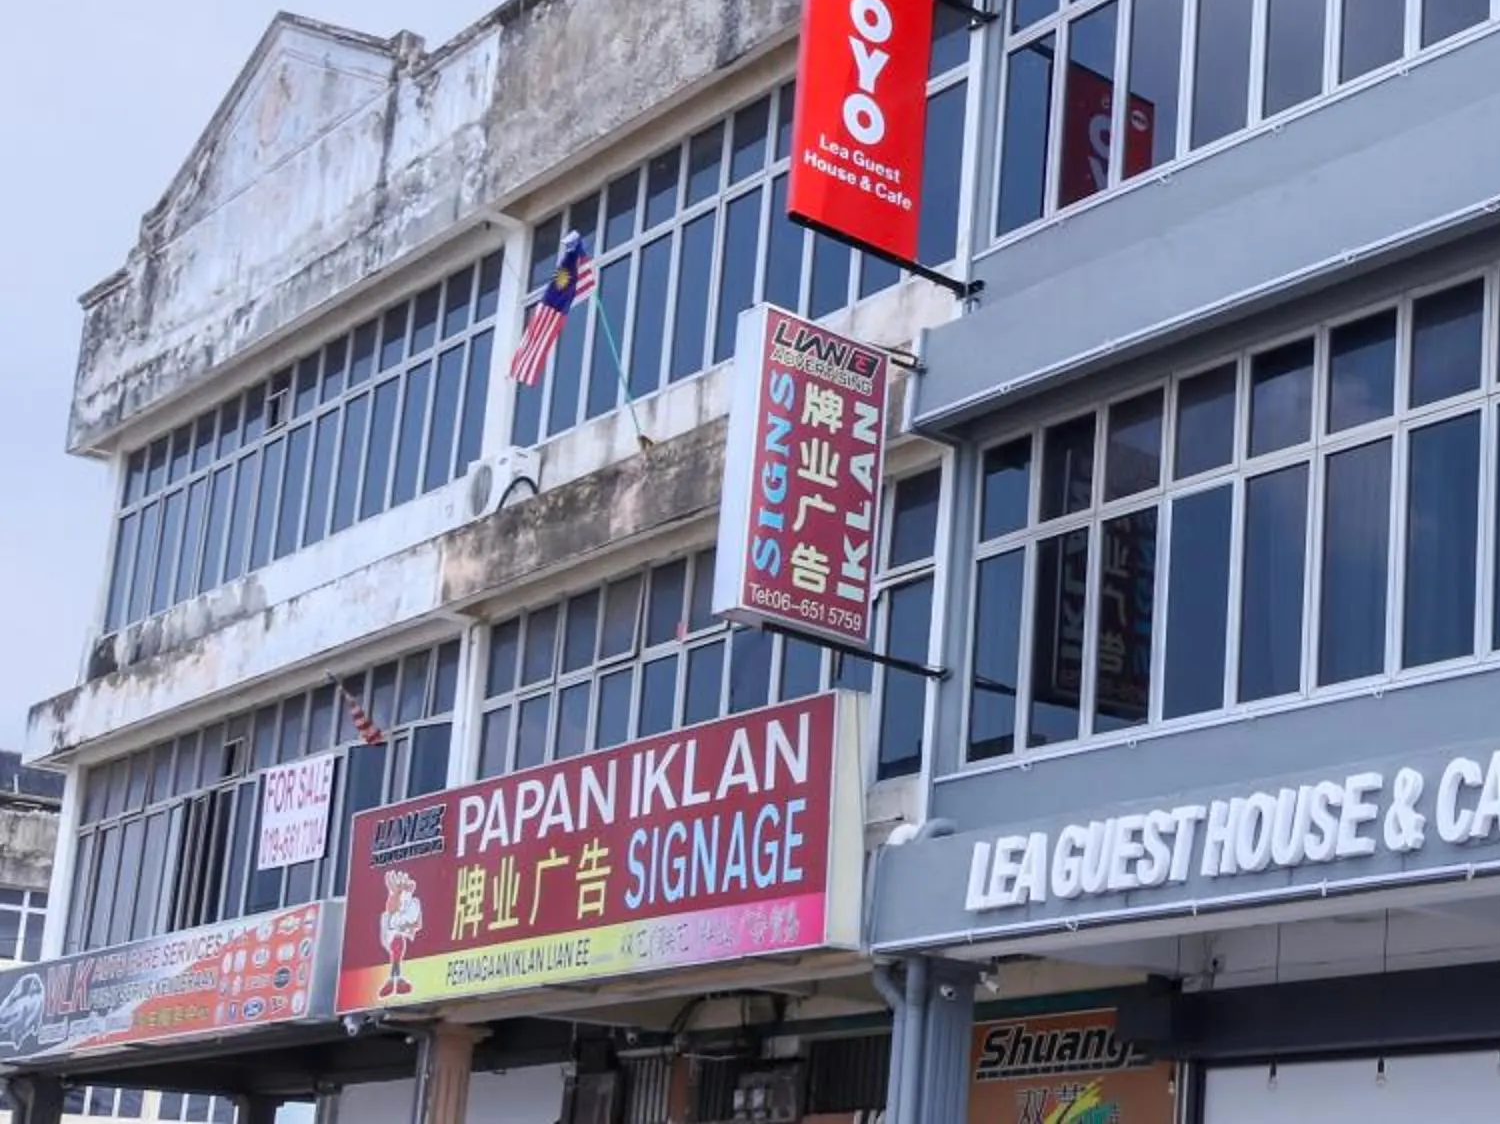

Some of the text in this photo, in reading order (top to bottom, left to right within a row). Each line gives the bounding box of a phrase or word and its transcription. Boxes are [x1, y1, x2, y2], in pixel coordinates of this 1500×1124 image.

[804, 149, 912, 211] House & Cafe
[819, 132, 901, 184] Lea Guest
[751, 369, 799, 578] SIGNS
[790, 380, 845, 594] 牌业广告
[836, 400, 879, 603] IKLAN
[827, 605, 862, 632] 5759
[265, 759, 332, 812] FOR SALE
[456, 713, 811, 859] PAPAN IKLAN
[964, 829, 1049, 912] LEA
[1050, 804, 1206, 901] GUEST
[1201, 771, 1384, 878] HOUSE
[1384, 766, 1427, 852] &
[451, 837, 612, 941] 牌业广告
[624, 798, 806, 910] SIGNAGE
